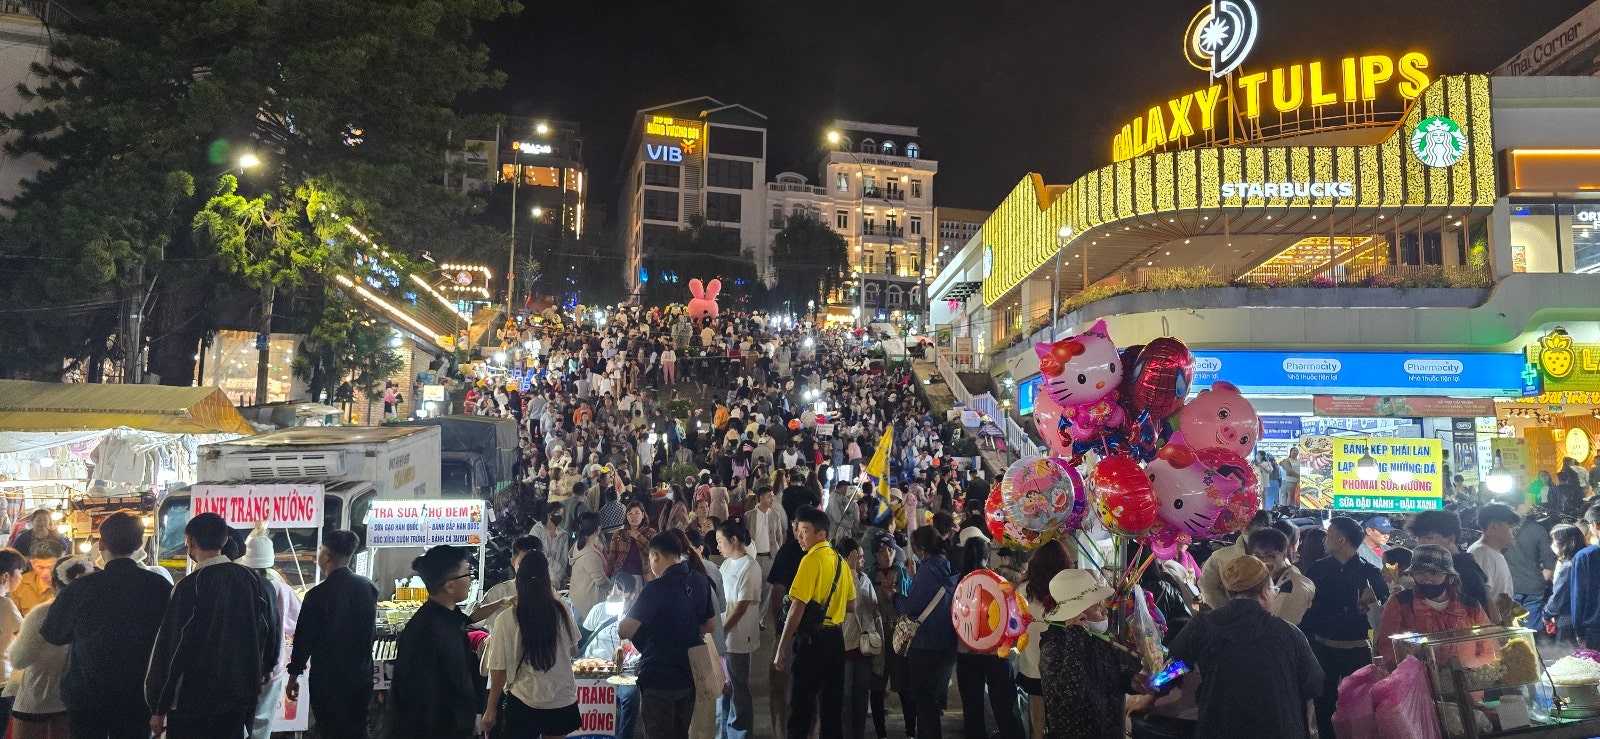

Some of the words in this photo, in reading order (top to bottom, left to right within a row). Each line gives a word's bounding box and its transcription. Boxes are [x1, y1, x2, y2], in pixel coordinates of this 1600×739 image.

[1533, 22, 1582, 63] Corner
[1112, 84, 1222, 162] GALAXY
[1238, 52, 1431, 119] TULIPS
[647, 144, 683, 162] VIB
[890, 160, 912, 168] HOTEL
[1222, 182, 1352, 197] STARBUCKS
[1286, 360, 1337, 371] Pharmacity
[1407, 361, 1459, 373] Pharmacity
[1413, 445, 1430, 456] LAN
[1342, 479, 1378, 490] PHOMAI
[231, 489, 270, 522] TRÁNG
[272, 489, 314, 521] NƯỚNG
[577, 681, 615, 704] TRÁNG
[579, 708, 614, 731] ƯỚNG
